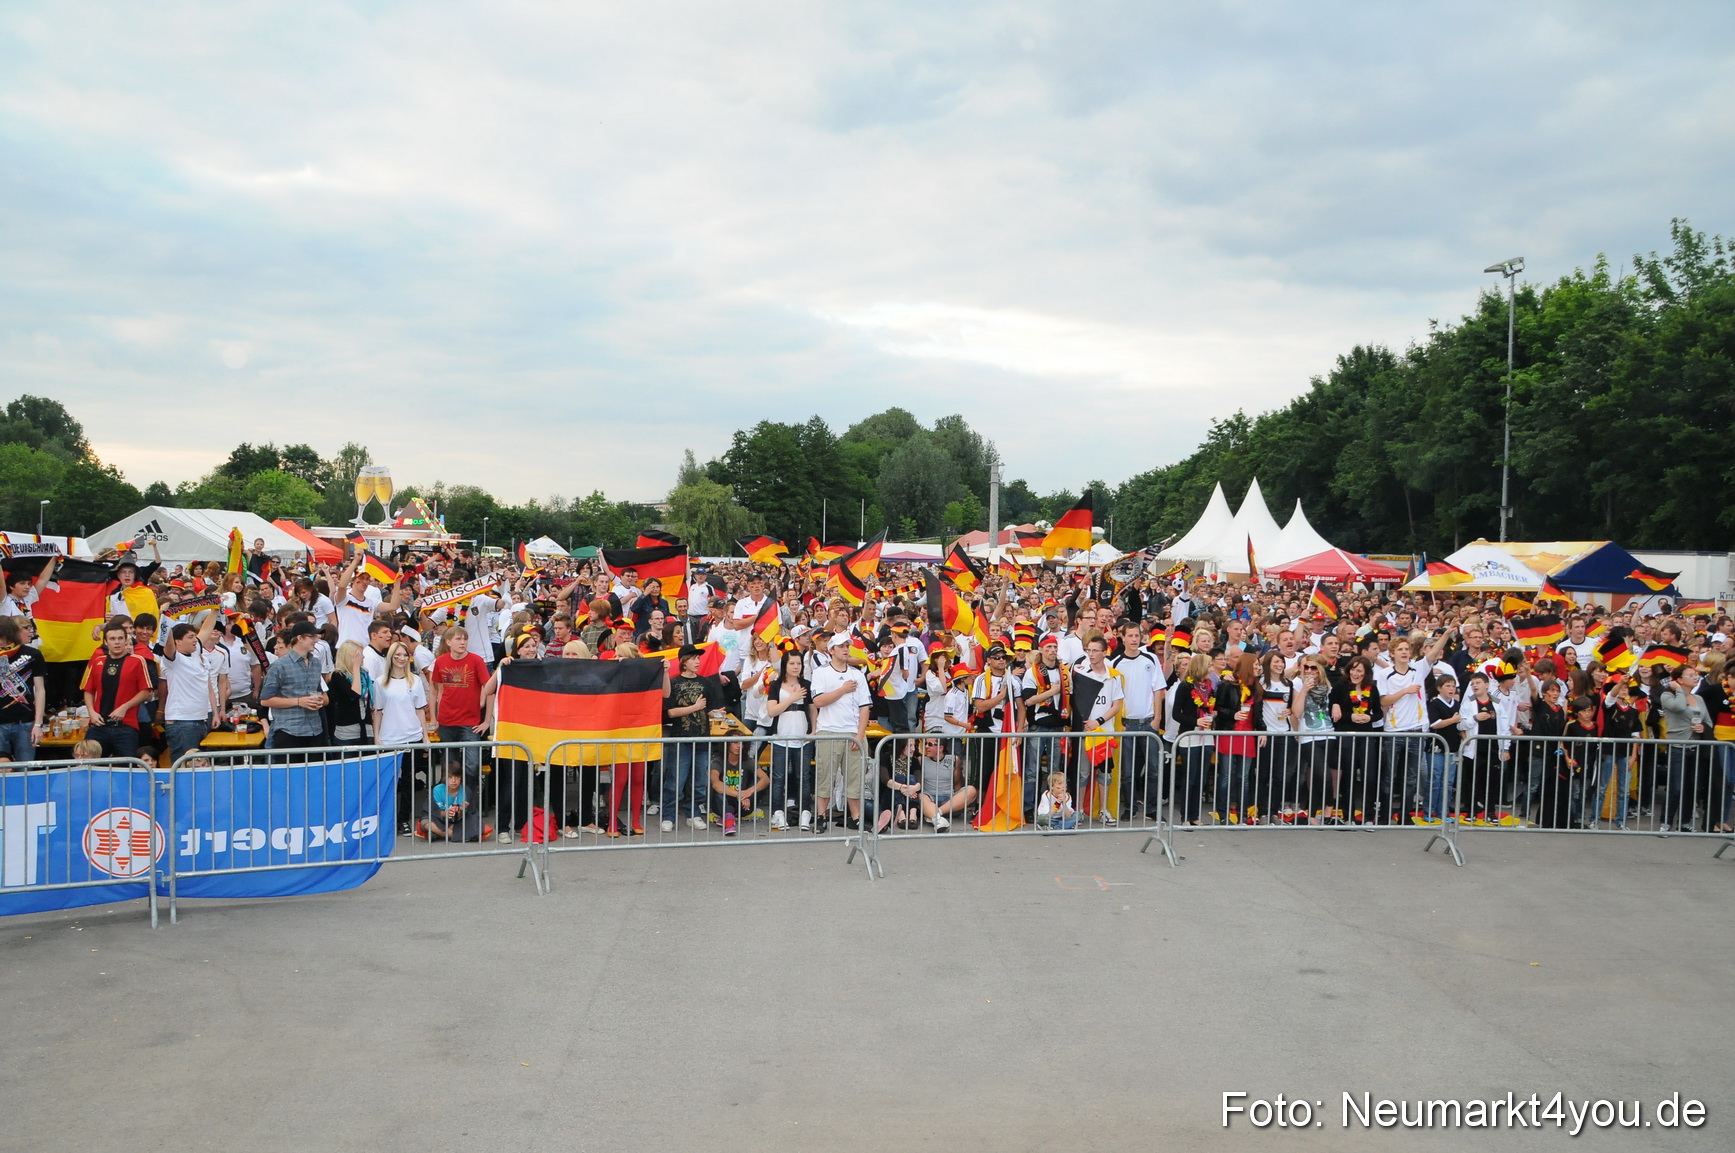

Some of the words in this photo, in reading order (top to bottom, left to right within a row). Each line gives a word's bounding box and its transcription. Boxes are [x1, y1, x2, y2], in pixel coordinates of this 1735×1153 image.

[1304, 574, 1338, 582] Krakauer
[1473, 570, 1528, 584] LMBACHER
[1095, 695, 1106, 705] 20
